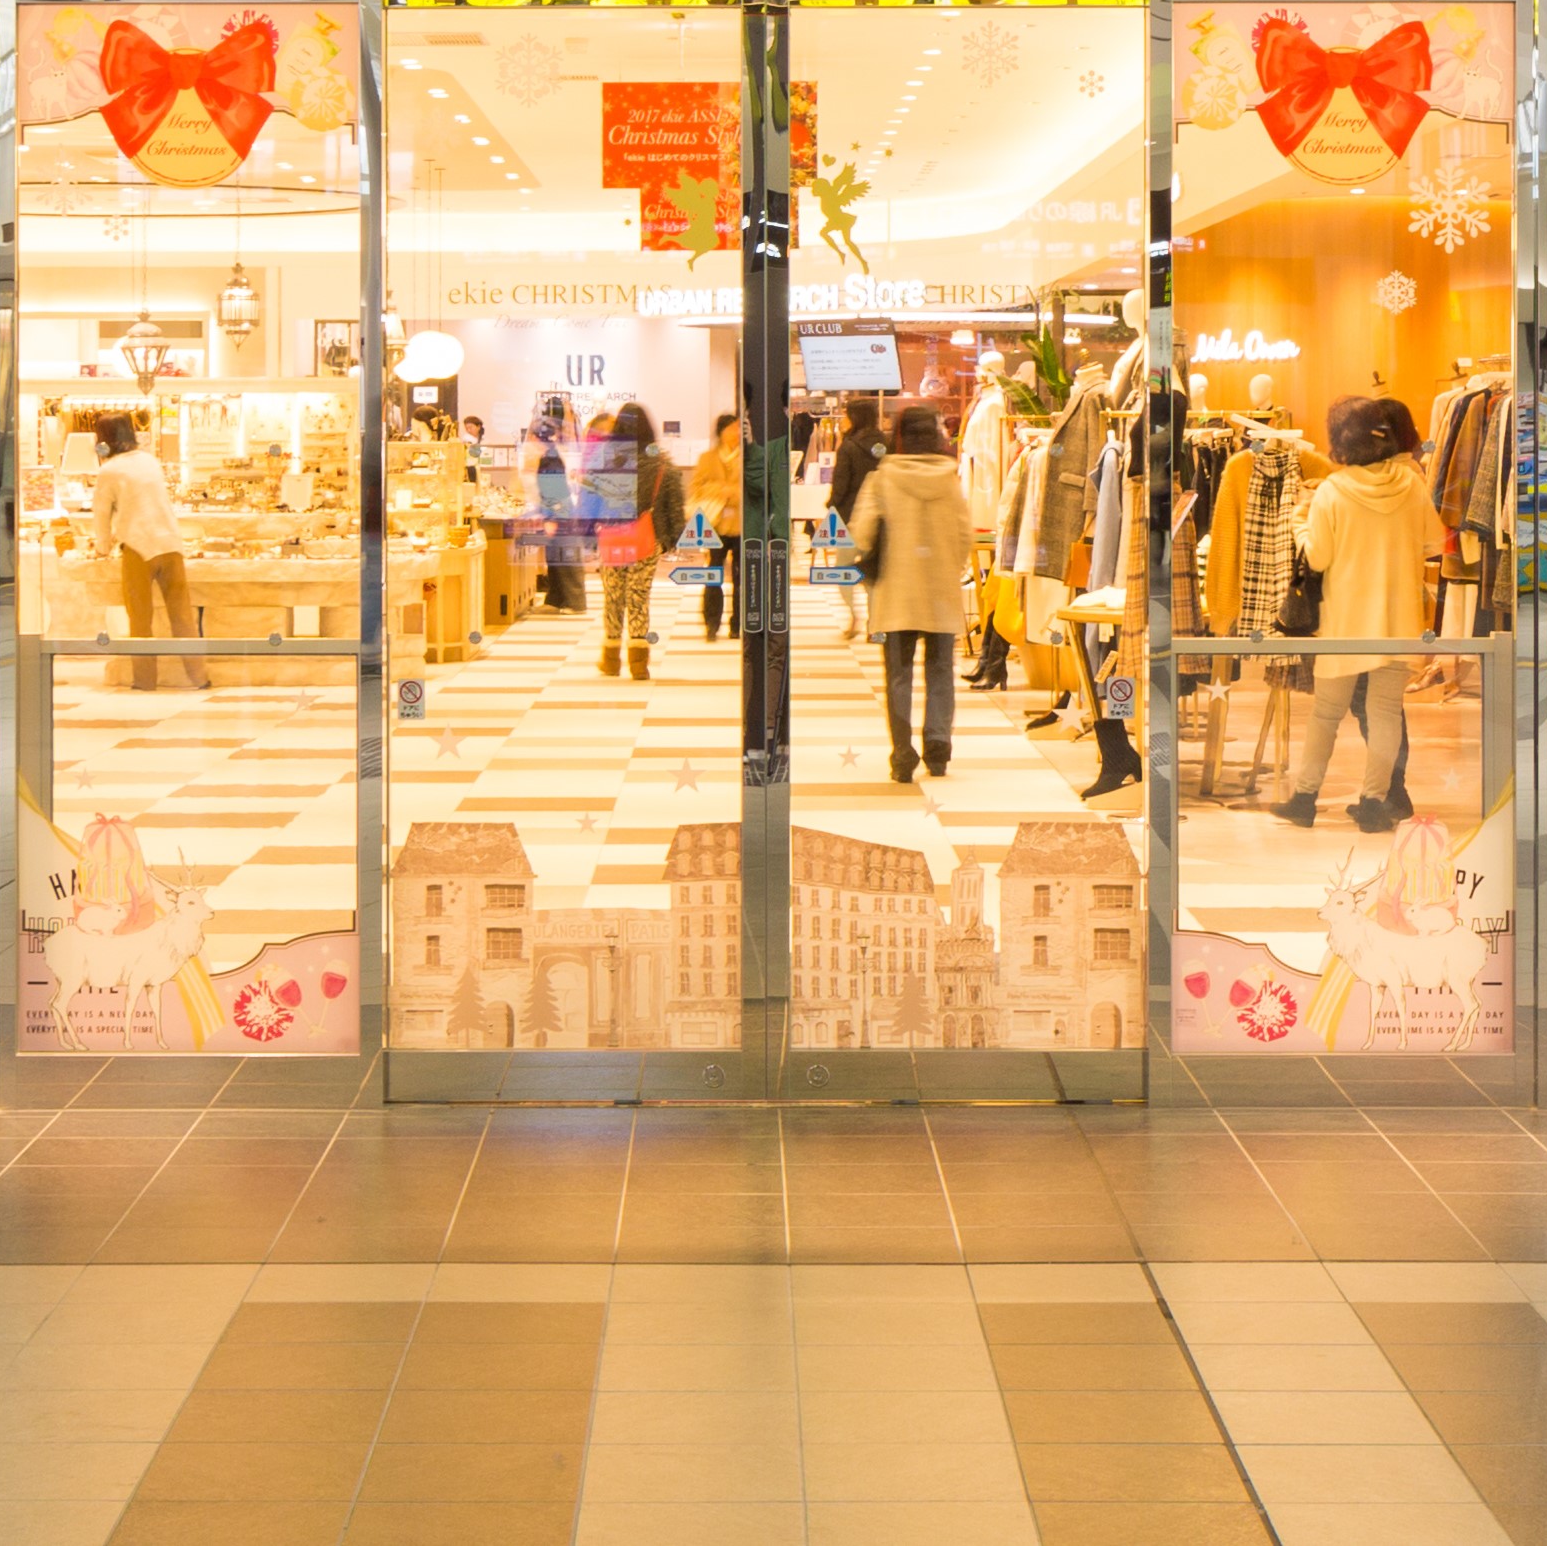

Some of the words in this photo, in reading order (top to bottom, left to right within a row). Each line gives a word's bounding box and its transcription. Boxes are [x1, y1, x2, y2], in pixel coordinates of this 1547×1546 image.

[166, 112, 214, 135] Merry
[626, 109, 660, 124] 2017
[661, 109, 685, 124] ekie
[1322, 110, 1369, 133] Merry
[607, 124, 699, 146] Christmas
[146, 139, 228, 157] Christmas
[1302, 137, 1384, 156] Christmas
[448, 280, 503, 304] ekie
[638, 287, 712, 316] URBAN
[845, 272, 926, 311] Store
[815, 323, 843, 334] CLUB
[566, 354, 606, 387] UR
[1411, 1010, 1429, 1019] DAY
[1486, 1010, 1504, 1019] DAY
